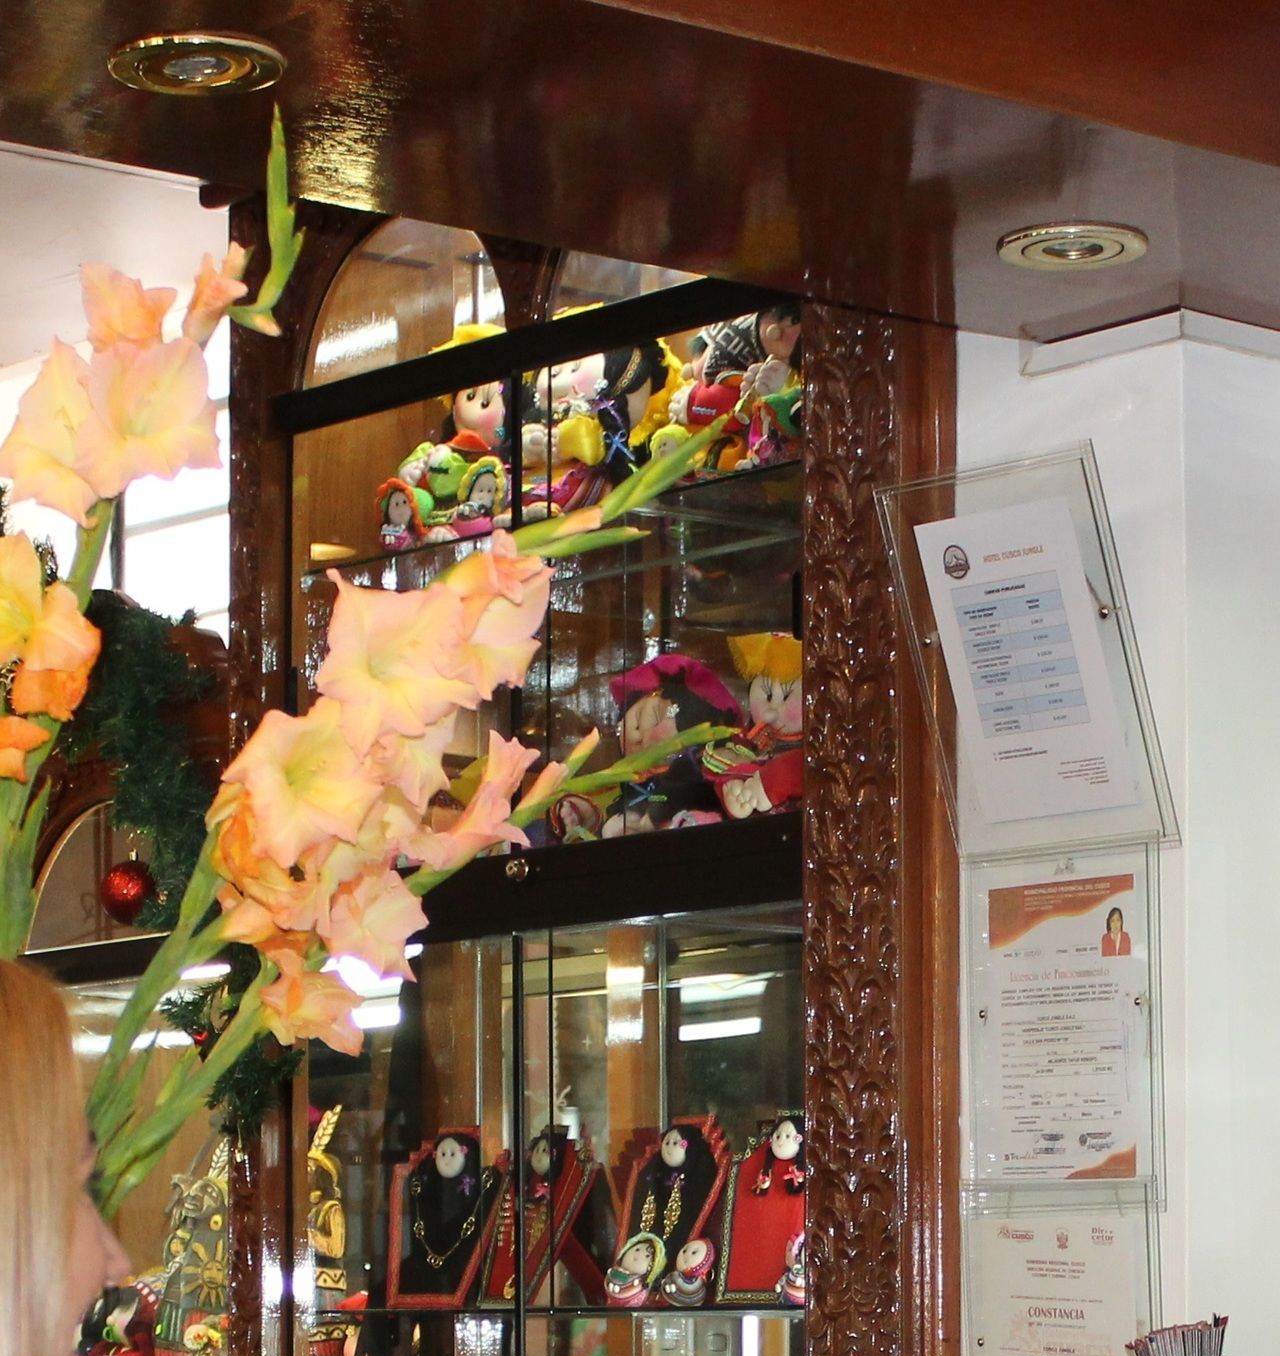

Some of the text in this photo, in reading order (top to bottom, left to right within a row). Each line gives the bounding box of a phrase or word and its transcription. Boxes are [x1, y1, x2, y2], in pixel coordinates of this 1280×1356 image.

[983, 545, 1044, 563] HOTEL CUSCO JUNGLE
[1028, 1306, 1085, 1320] CONSTANCIA
